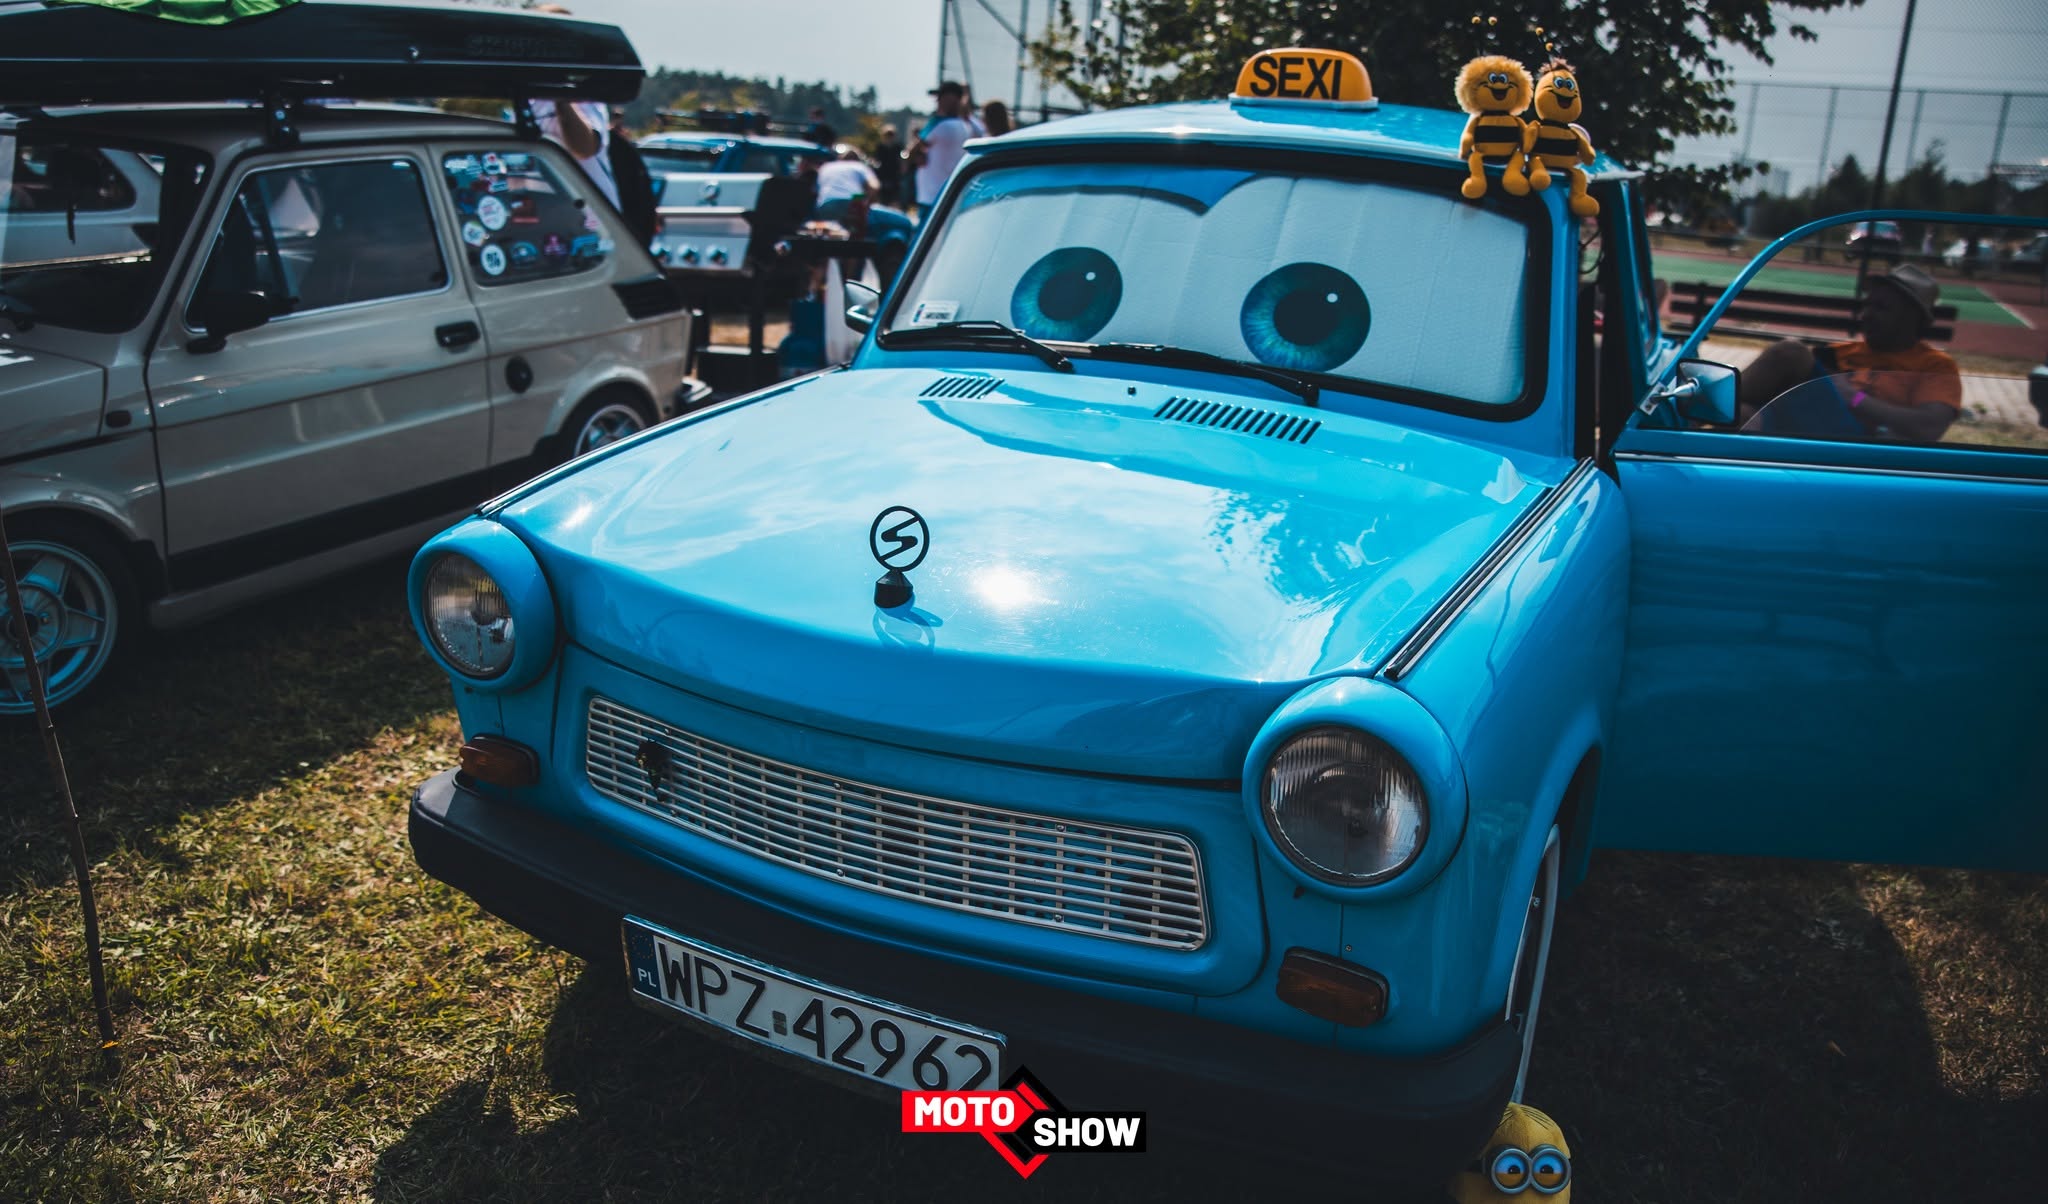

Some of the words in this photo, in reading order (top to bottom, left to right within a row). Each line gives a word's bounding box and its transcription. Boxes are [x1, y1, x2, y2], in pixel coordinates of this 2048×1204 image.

[1250, 56, 1342, 100] SEXI
[637, 967, 657, 988] PL
[658, 942, 770, 1039] WPZ
[793, 998, 991, 1091] 42962
